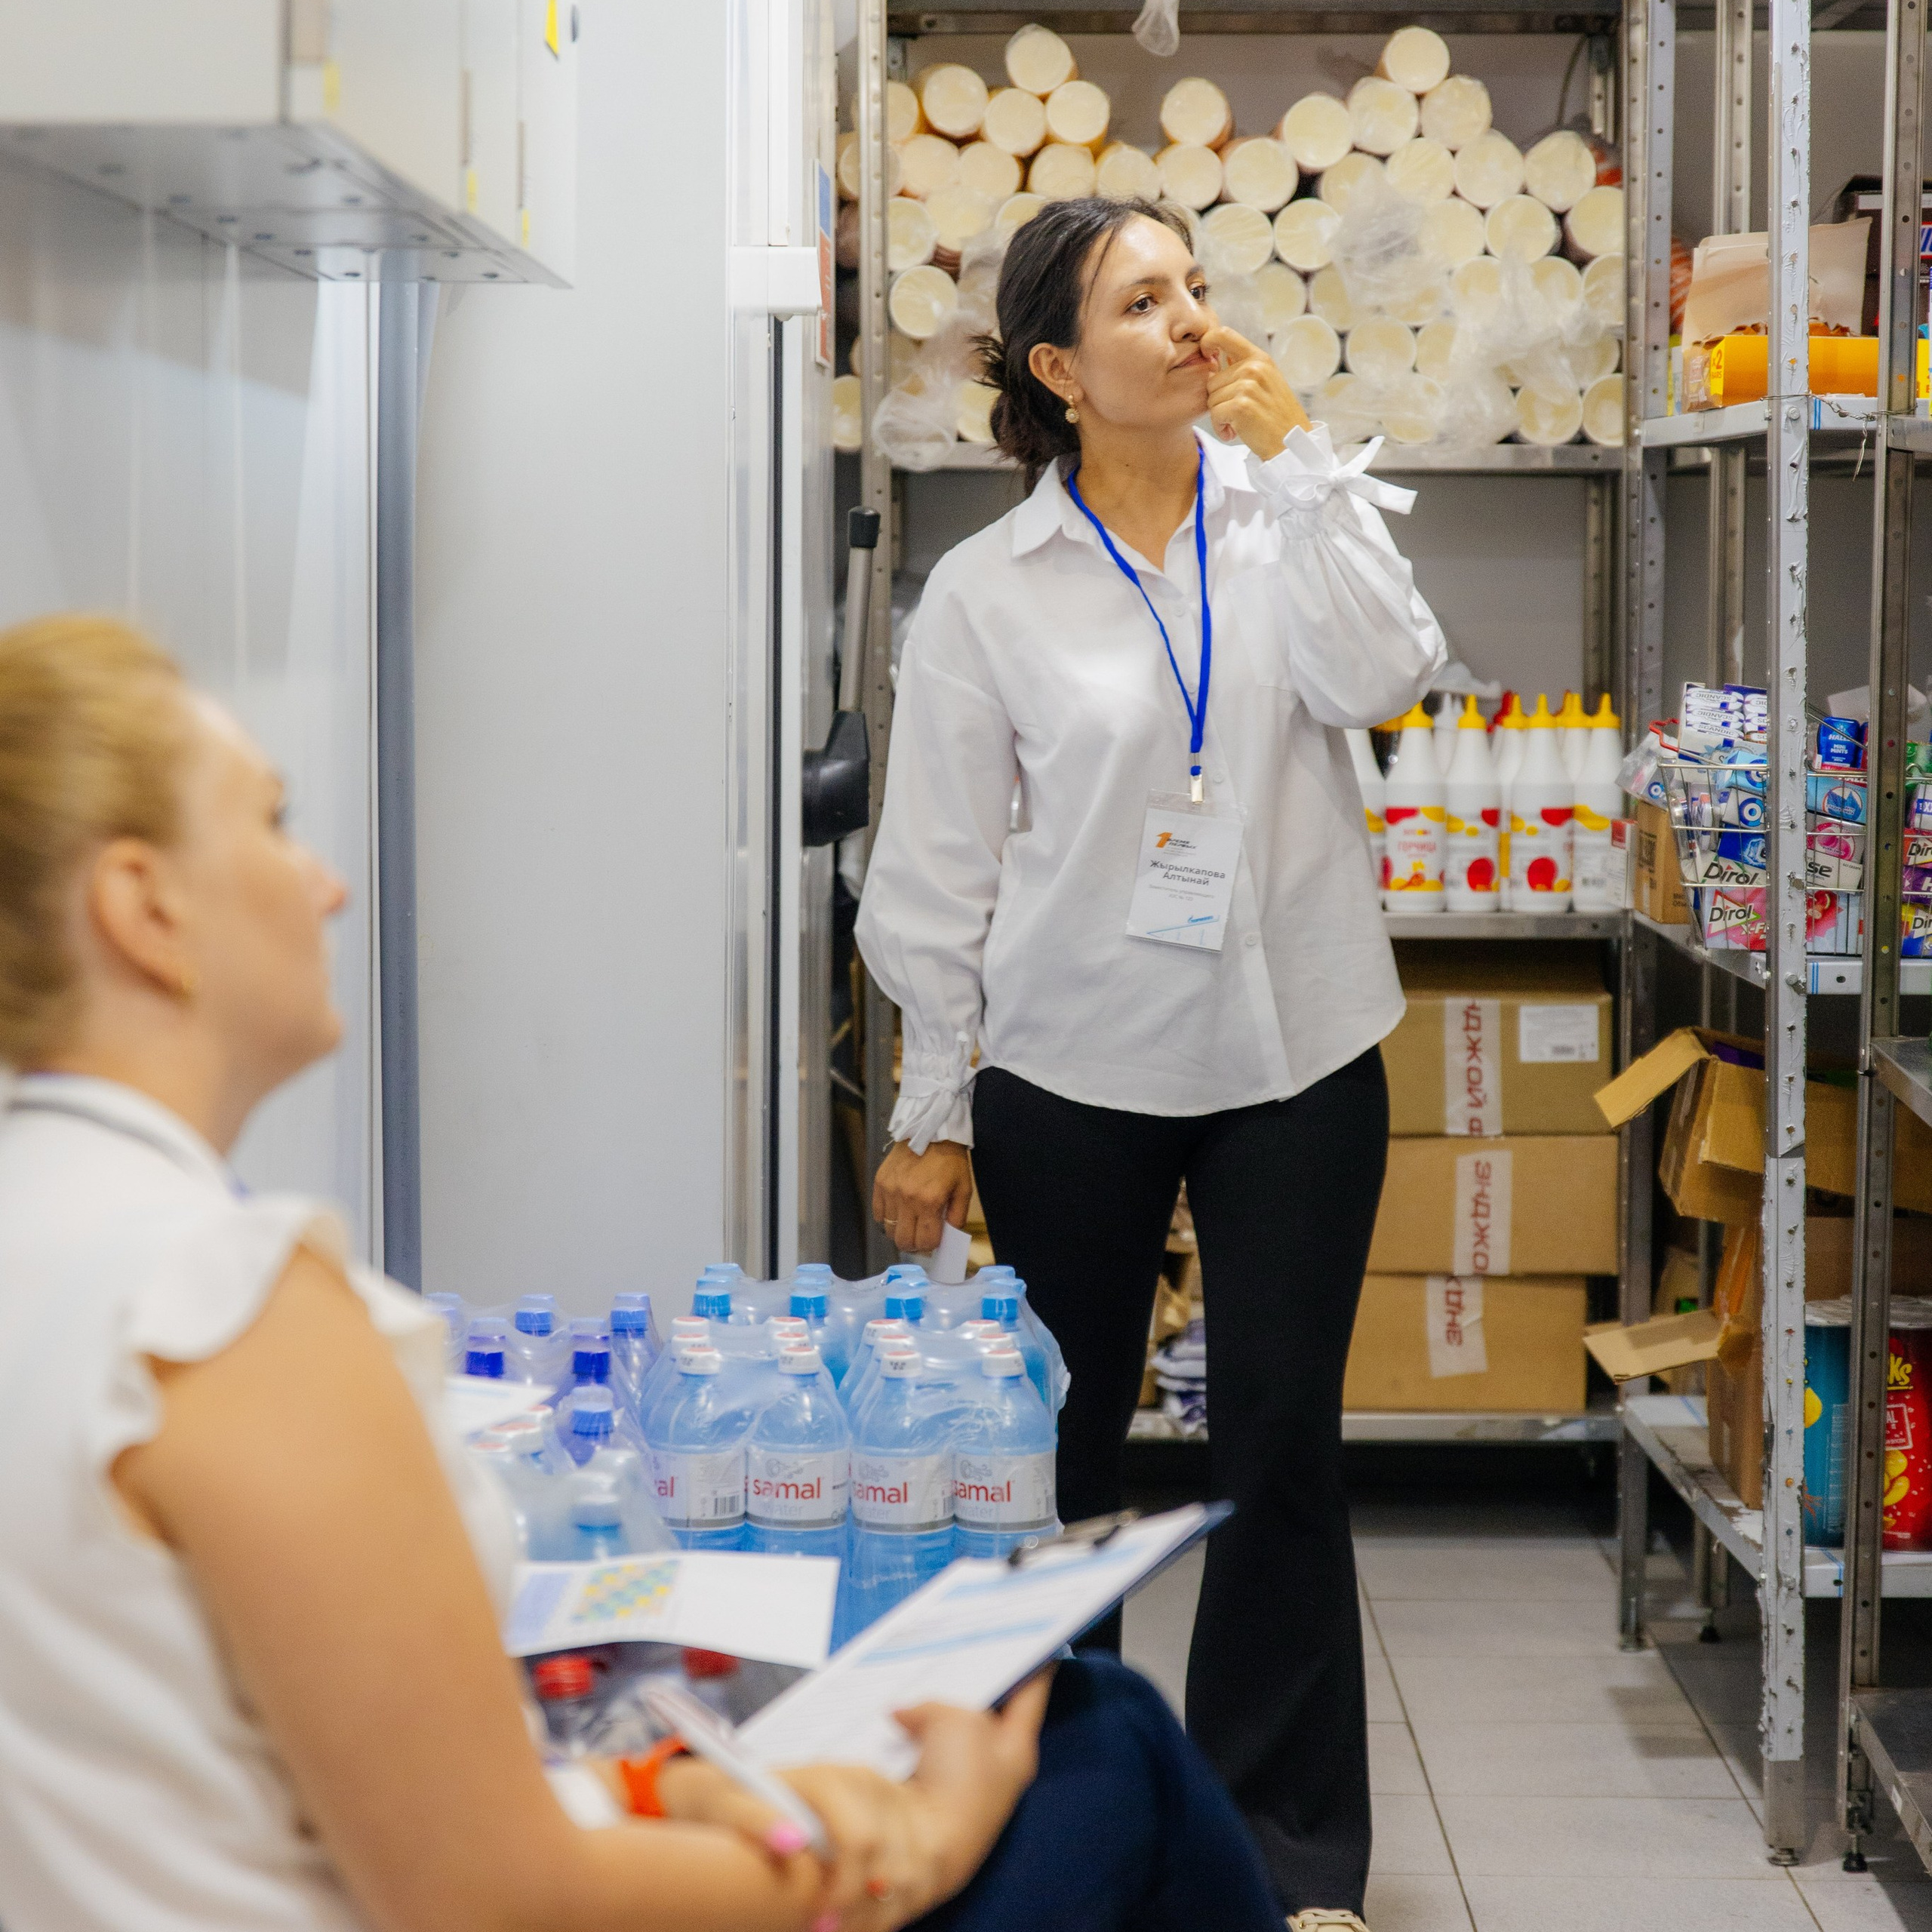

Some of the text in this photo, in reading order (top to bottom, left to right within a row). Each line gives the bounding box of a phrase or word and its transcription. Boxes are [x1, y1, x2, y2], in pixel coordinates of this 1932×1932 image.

[1696, 693, 1733, 701] SCANDIC
[1697, 710, 1734, 721] SCANDIC
[1698, 724, 1734, 737] SCANDIC
[1162, 871, 1209, 886] Алтынай
[1703, 862, 1759, 885] Dirol
[1709, 904, 1752, 923] Dirol
[752, 1476, 822, 1500] samal
[852, 1481, 909, 1503] amal
